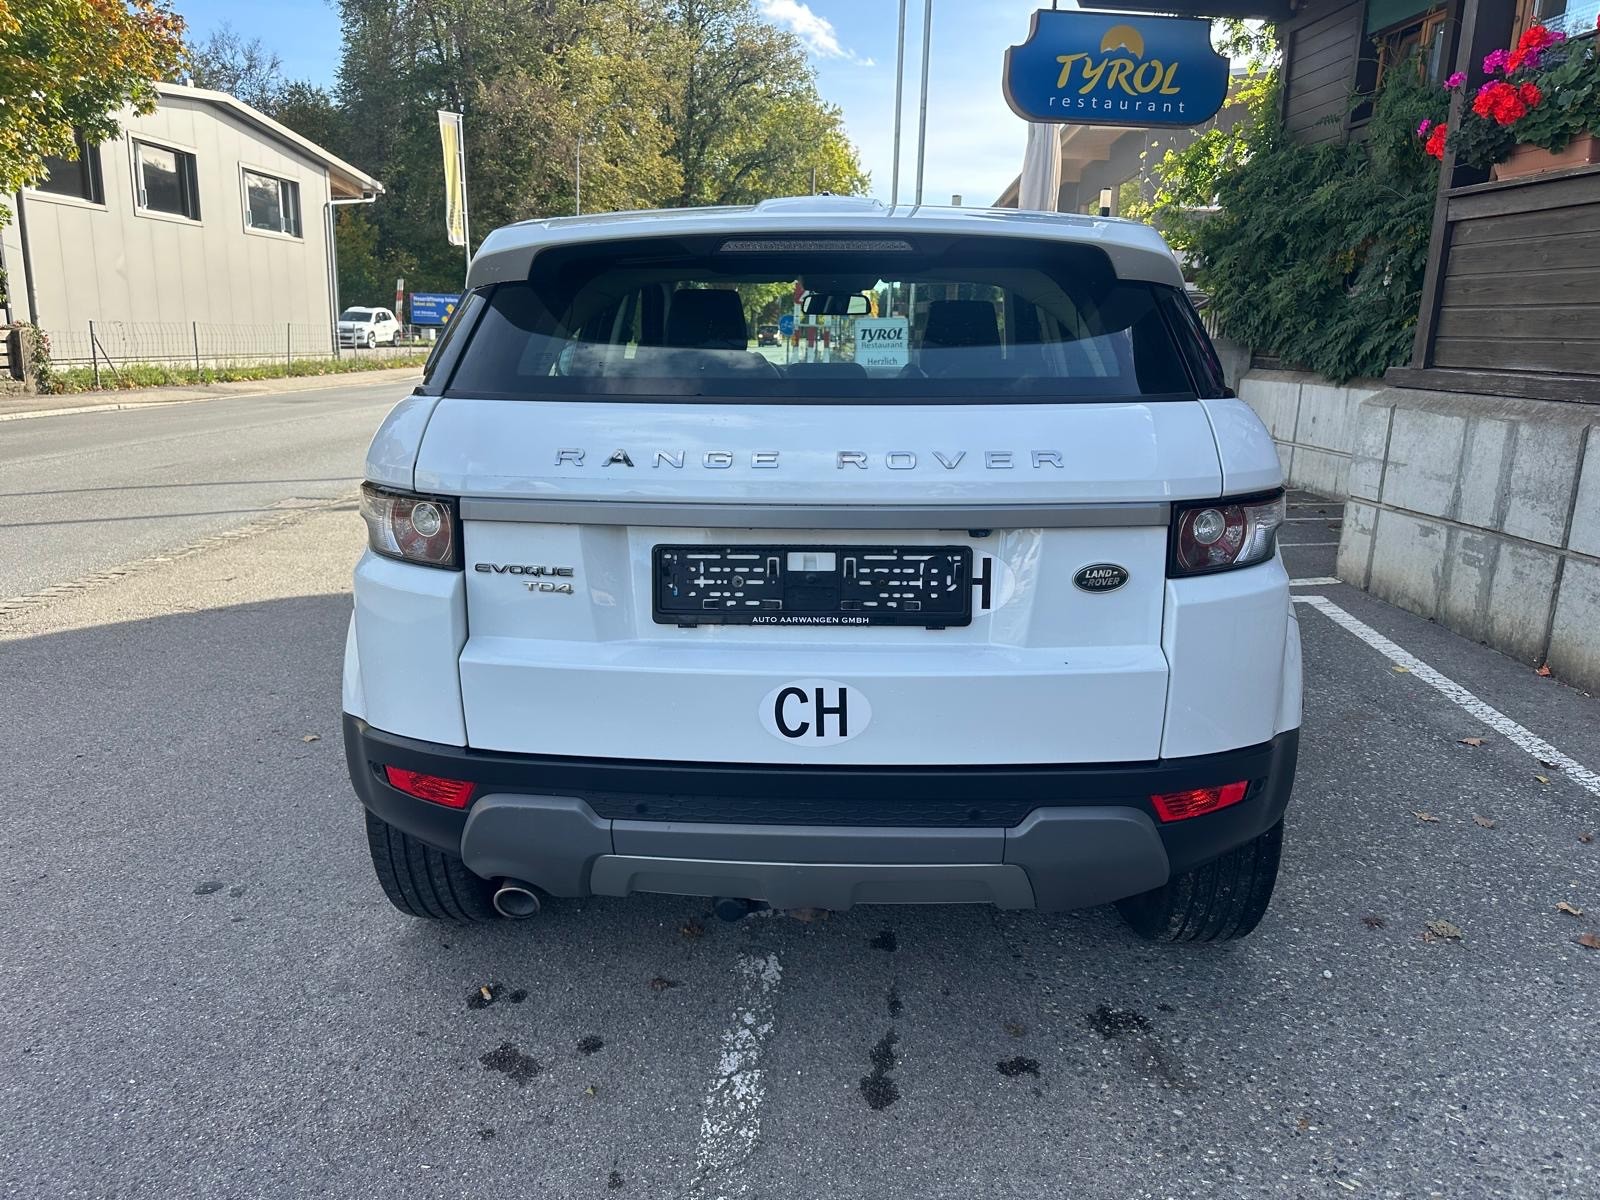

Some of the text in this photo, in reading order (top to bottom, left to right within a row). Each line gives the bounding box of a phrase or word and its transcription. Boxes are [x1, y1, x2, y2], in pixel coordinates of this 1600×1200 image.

[1056, 52, 1181, 96] TYROL
[1049, 96, 1185, 113] restaurant
[860, 328, 903, 343] TYROL
[861, 341, 903, 349] Restaurant
[867, 357, 898, 366] Herzlich
[554, 448, 1065, 470] RANGE ROVER
[474, 563, 575, 578] EVOQUE
[523, 581, 575, 595] TD4
[779, 616, 839, 624] AARWANGEN
[774, 686, 848, 738] CH
